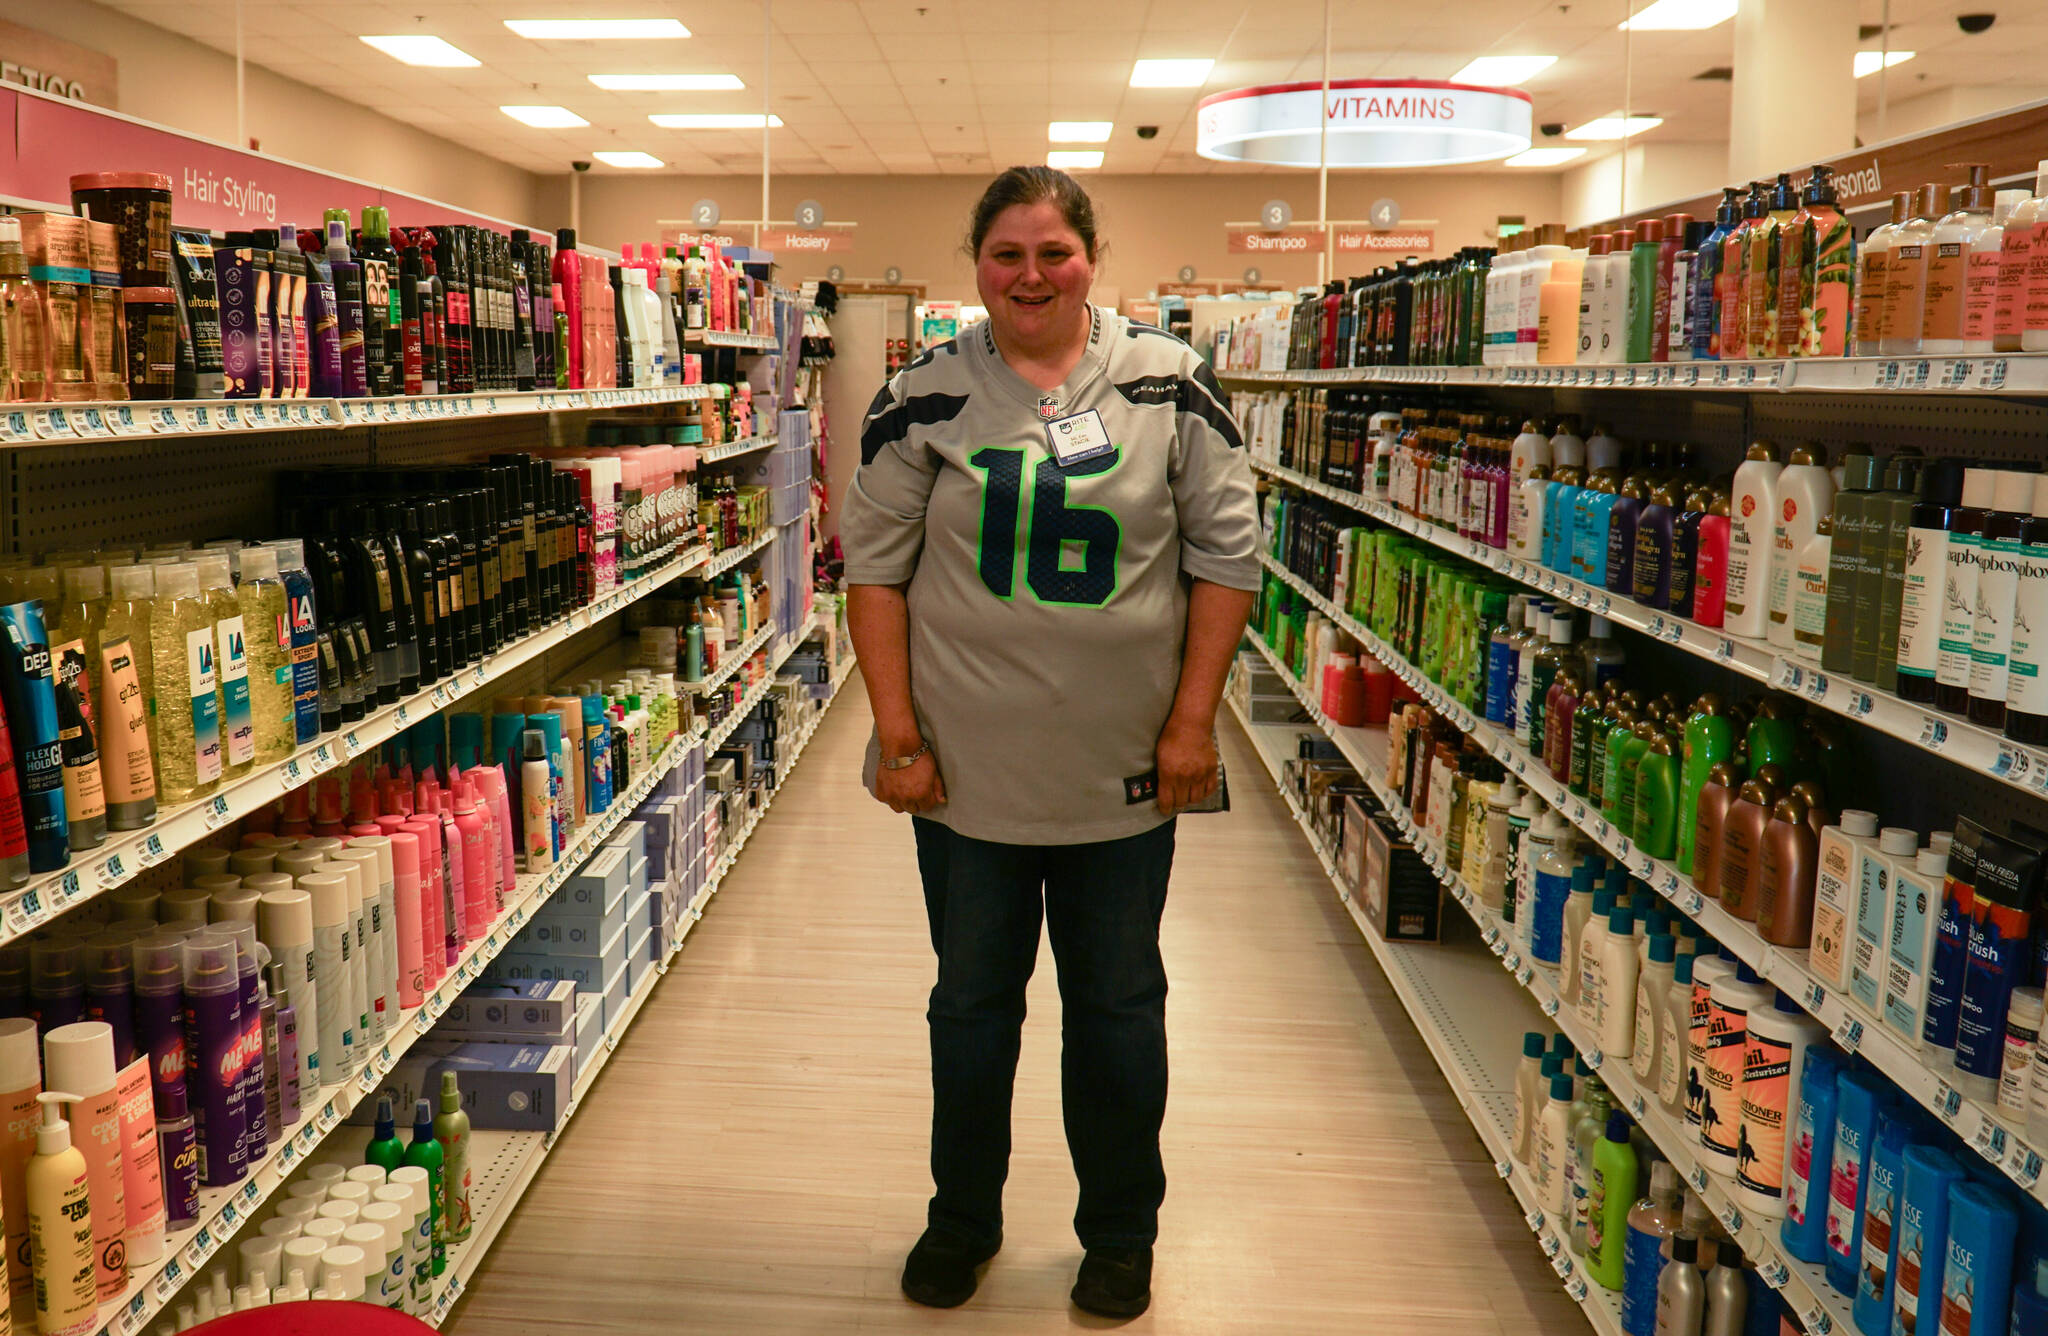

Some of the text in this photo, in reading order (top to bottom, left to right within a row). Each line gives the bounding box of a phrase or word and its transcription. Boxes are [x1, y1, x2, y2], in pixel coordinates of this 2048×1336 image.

[1327, 97, 1455, 121] VITAMINS
[184, 167, 276, 222] Hair Styling
[699, 211, 711, 223] 2
[803, 208, 814, 223] 3
[1270, 207, 1282, 223] 3
[1379, 206, 1390, 222] 4
[786, 234, 830, 250] Hosiery
[1247, 235, 1307, 253] Shampoo
[1340, 233, 1429, 250] Hair Accessories
[1183, 268, 1192, 280] 3
[1041, 405, 1058, 417] NFL
[1071, 416, 1089, 427] RITE
[968, 443, 1123, 609] 16
[292, 595, 315, 628] LA
[295, 622, 316, 634] LOOKS
[199, 644, 214, 675] LA
[229, 641, 246, 671] LA
[293, 646, 316, 658] EXTREME
[23, 651, 49, 673] DEP
[26, 747, 50, 762] FLEX
[2013, 748, 2030, 774] 7.99
[26, 758, 51, 774] HOLD
[1998, 866, 2020, 883] FRIEDA
[1967, 939, 2000, 963] crush
[119, 1082, 131, 1095] MARC
